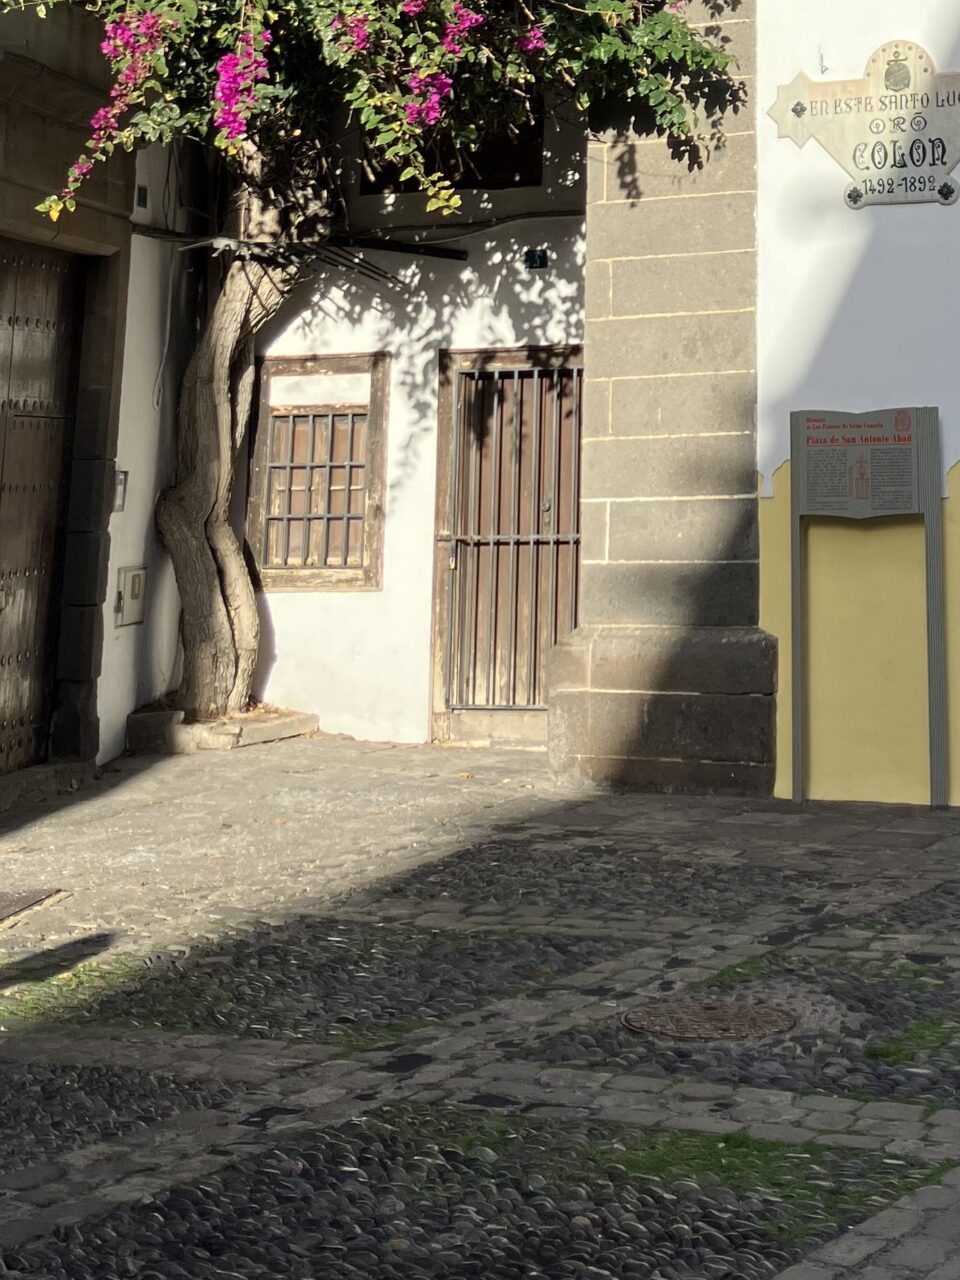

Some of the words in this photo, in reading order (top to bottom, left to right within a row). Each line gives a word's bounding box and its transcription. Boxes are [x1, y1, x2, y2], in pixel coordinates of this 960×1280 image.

[810, 100, 829, 117] EN
[834, 96, 874, 116] ESTE
[878, 93, 930, 111] SANTO
[852, 137, 947, 171] COLON
[806, 435, 828, 445] Plaza
[830, 435, 839, 444] de
[842, 435, 857, 444] San
[860, 434, 889, 443] Antonio
[893, 434, 912, 442] Abad
